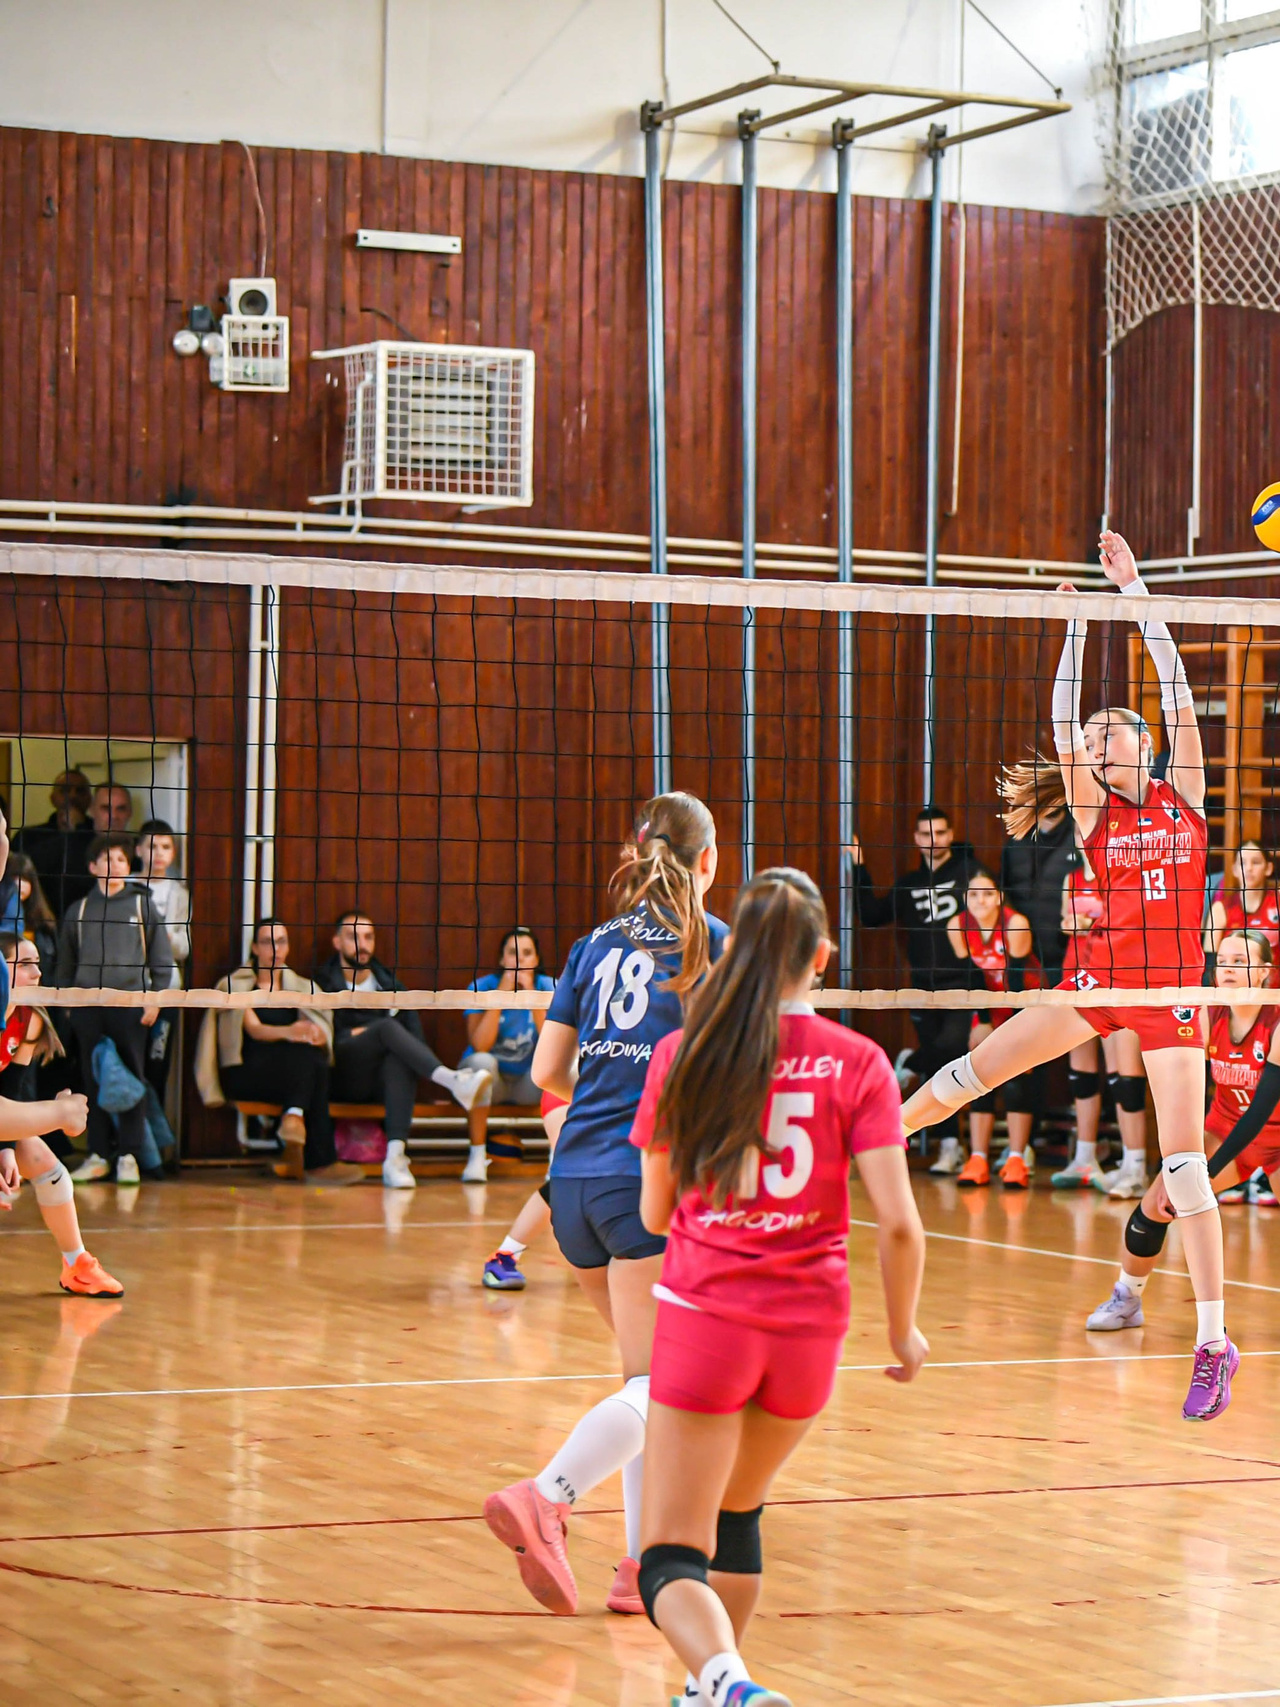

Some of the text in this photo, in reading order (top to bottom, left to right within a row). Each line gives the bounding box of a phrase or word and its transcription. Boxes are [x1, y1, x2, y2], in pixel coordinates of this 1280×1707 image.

[1142, 868, 1167, 900] 13
[592, 947, 655, 1030] 18
[771, 1055, 844, 1080] OLLEY
